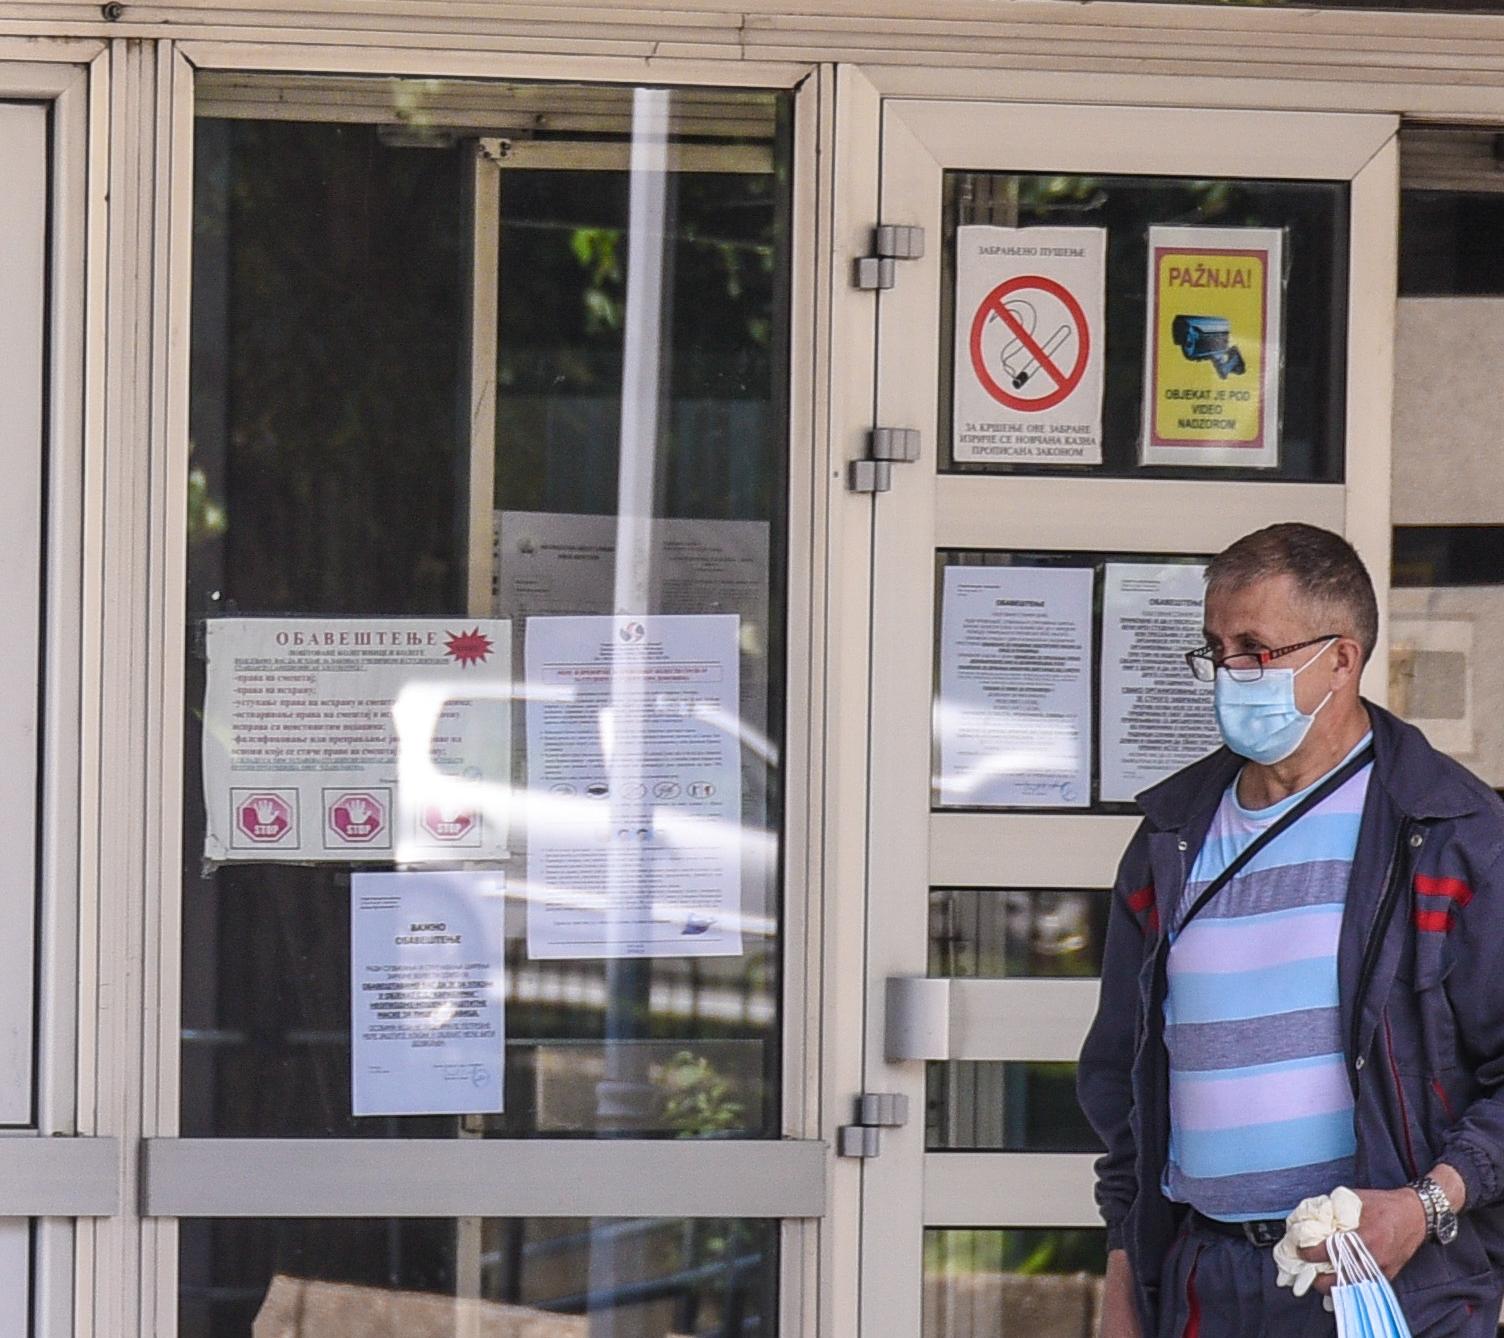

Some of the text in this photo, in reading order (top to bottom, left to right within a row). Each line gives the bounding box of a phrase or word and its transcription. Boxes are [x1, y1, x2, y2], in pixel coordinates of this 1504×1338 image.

[1168, 262, 1253, 289] PAŽNJA!
[1165, 388, 1251, 402] OBJEKAT JE POD
[1191, 403, 1223, 415] VIDEO
[1177, 418, 1237, 430] NADZOROM
[275, 629, 439, 647] ОБАВЕШТЕЊЕ
